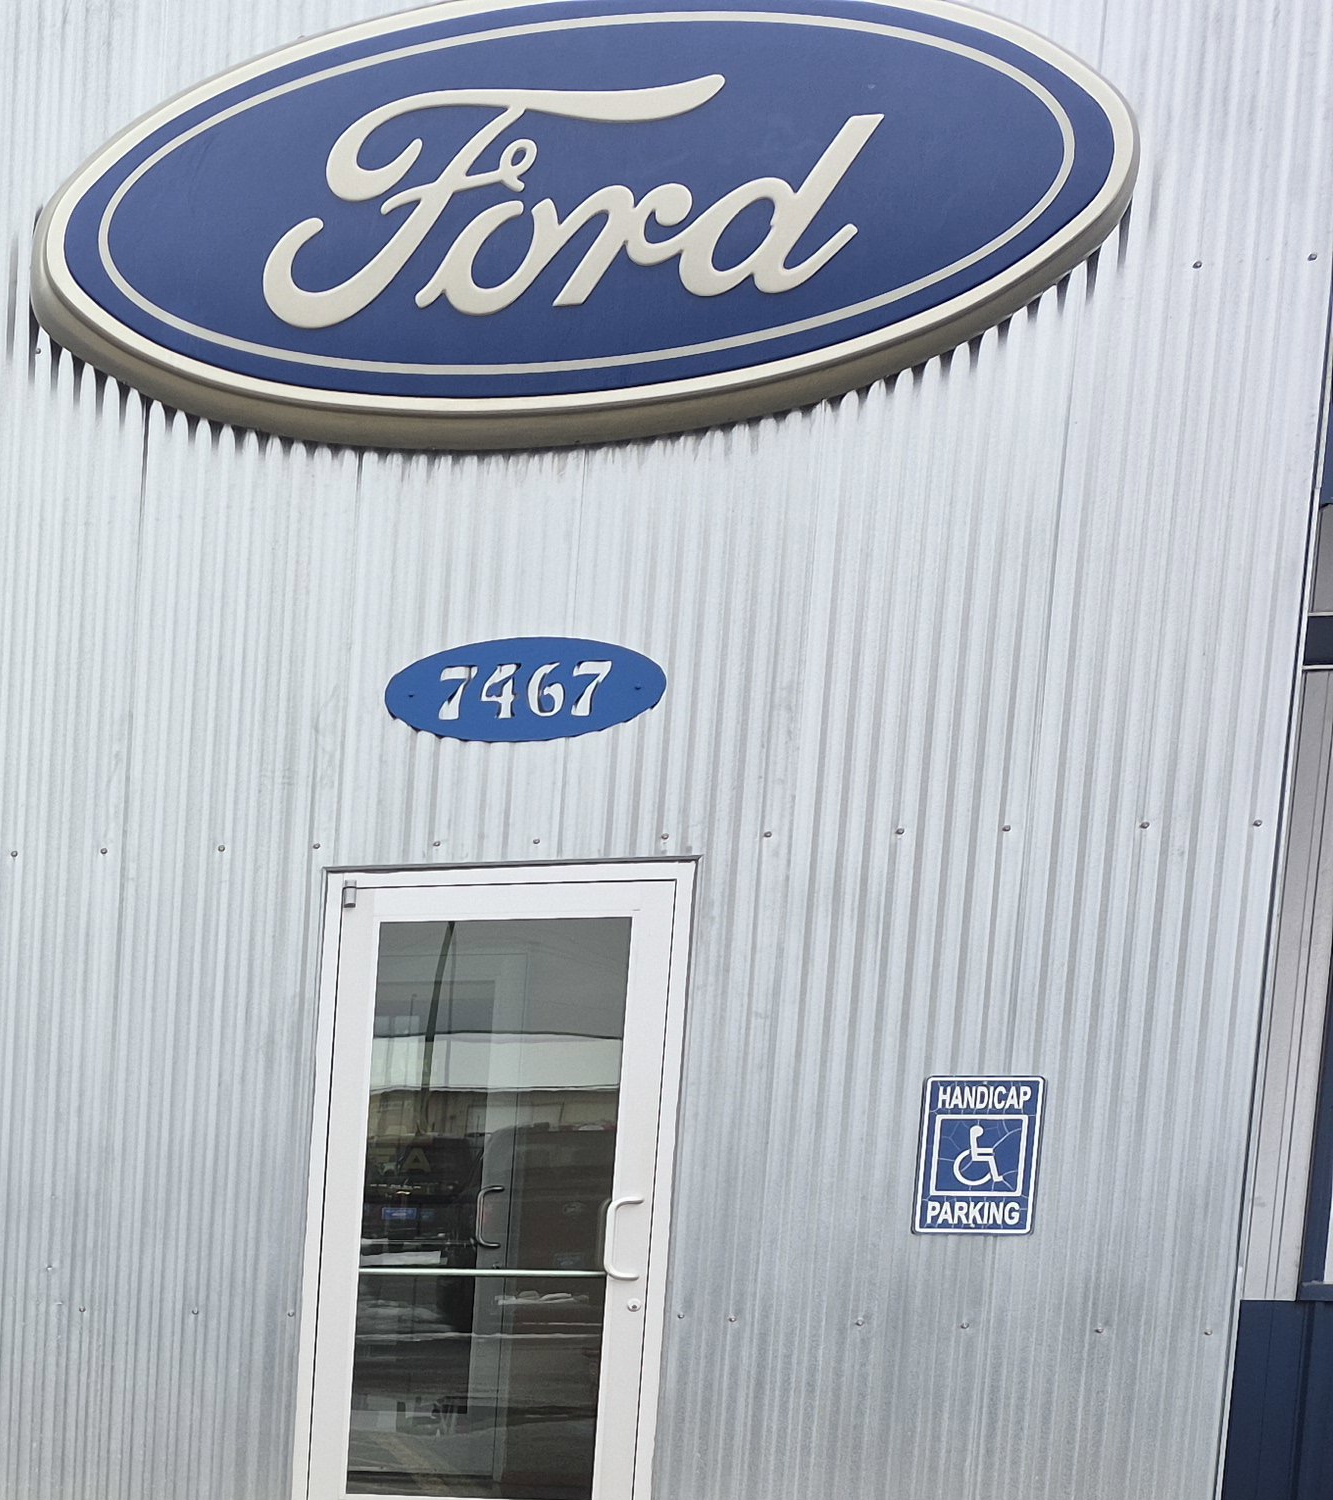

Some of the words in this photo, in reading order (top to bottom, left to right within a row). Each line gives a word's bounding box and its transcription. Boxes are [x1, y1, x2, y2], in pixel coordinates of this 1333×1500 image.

[262, 72, 884, 329] Ford
[437, 659, 612, 721] 7467
[937, 1084, 1032, 1110] HANDICAP
[926, 1201, 1021, 1225] PARKING
